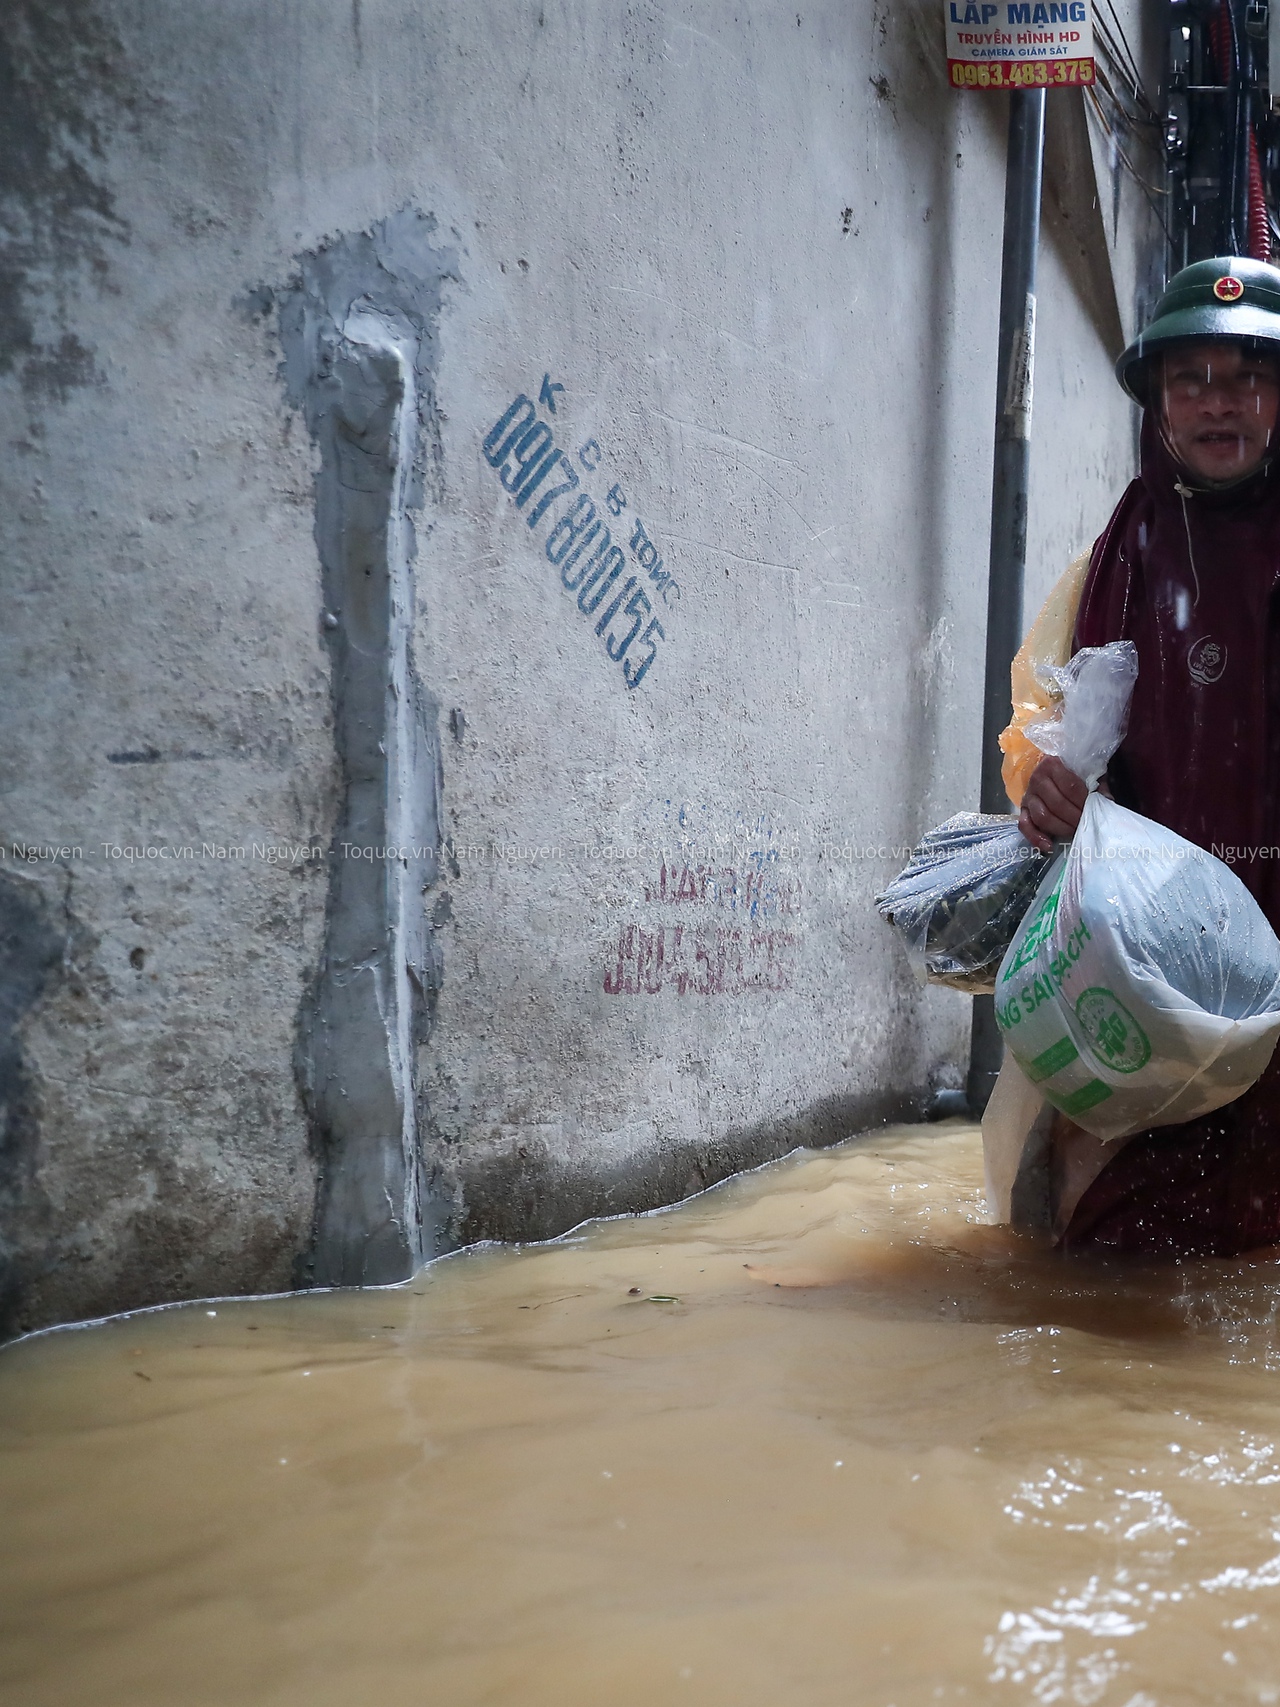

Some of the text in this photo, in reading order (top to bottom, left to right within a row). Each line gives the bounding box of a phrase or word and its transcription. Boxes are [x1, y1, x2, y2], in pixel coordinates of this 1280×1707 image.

[1007, 1, 1086, 28] MẠNG
[957, 28, 1080, 45] TRUYỀN HÌNH HD
[971, 45, 1068, 57] CAMERA GIÁM SÁT
[951, 60, 1093, 87] 0963.483.375
[538, 372, 566, 415] K
[579, 437, 602, 472] C
[606, 482, 628, 517] B
[995, 996, 1022, 1030] NG
